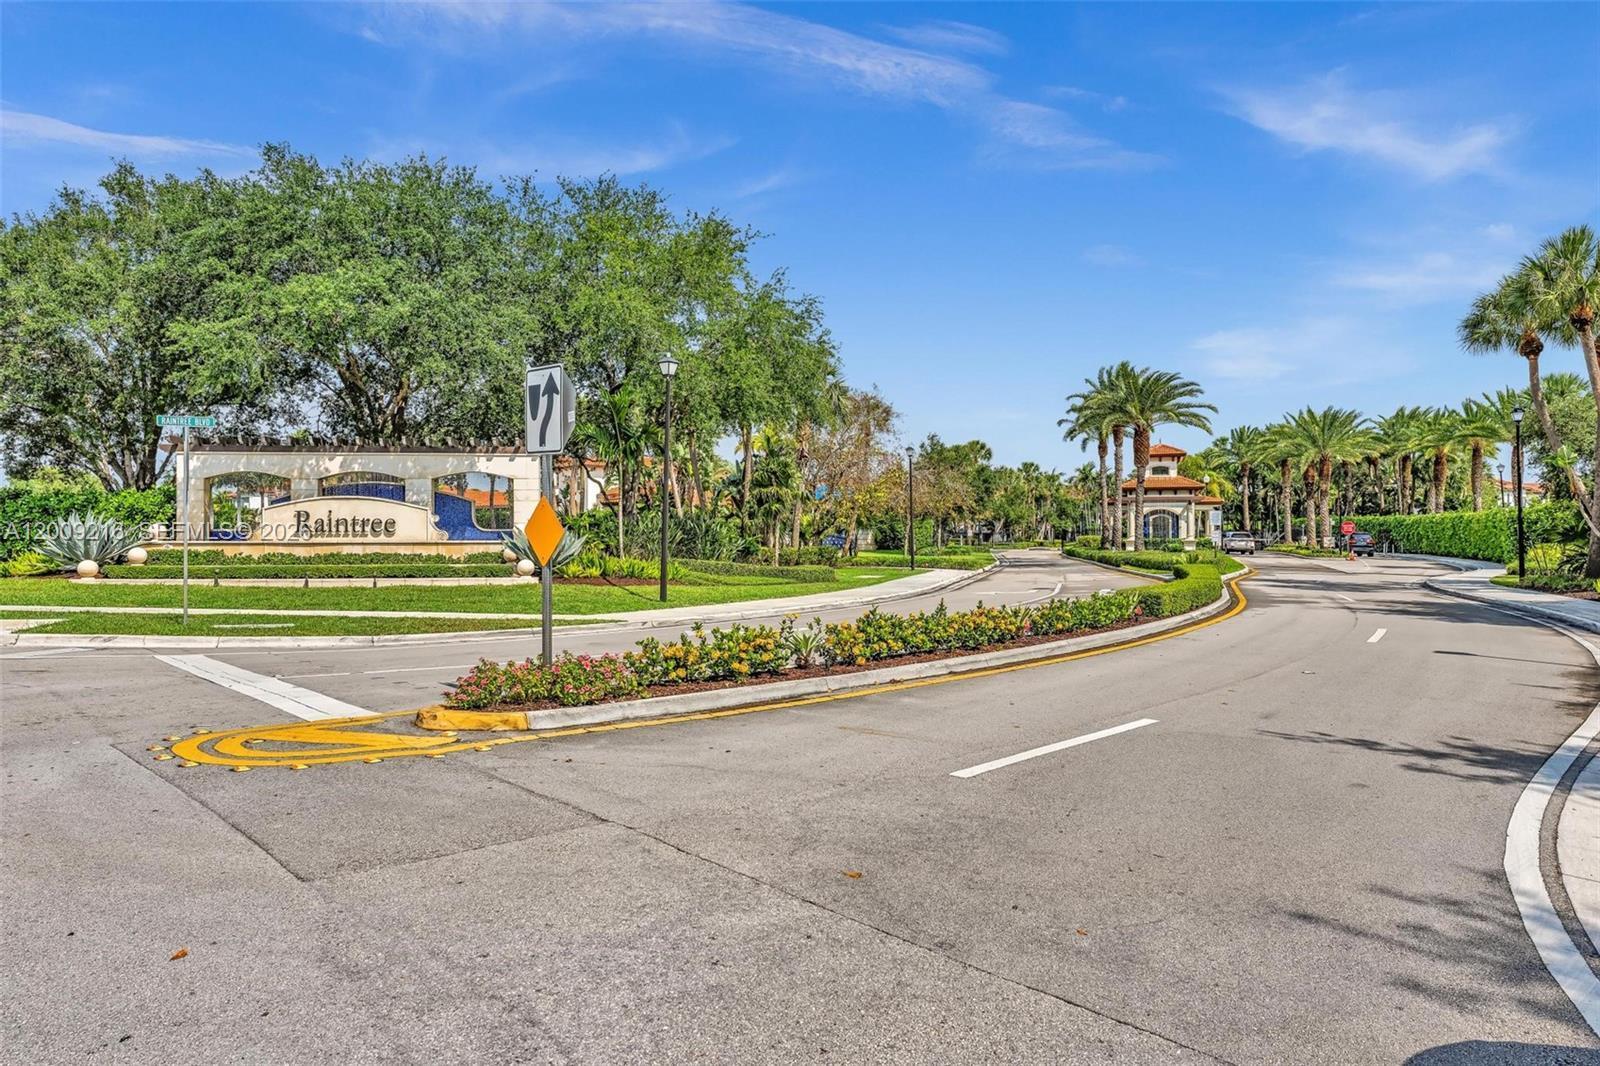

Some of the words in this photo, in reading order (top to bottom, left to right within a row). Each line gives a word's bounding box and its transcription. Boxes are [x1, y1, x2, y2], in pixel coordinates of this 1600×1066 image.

[162, 416, 192, 426] RAINTREE
[194, 417, 211, 427] BLVD
[294, 510, 397, 537] Raintree
